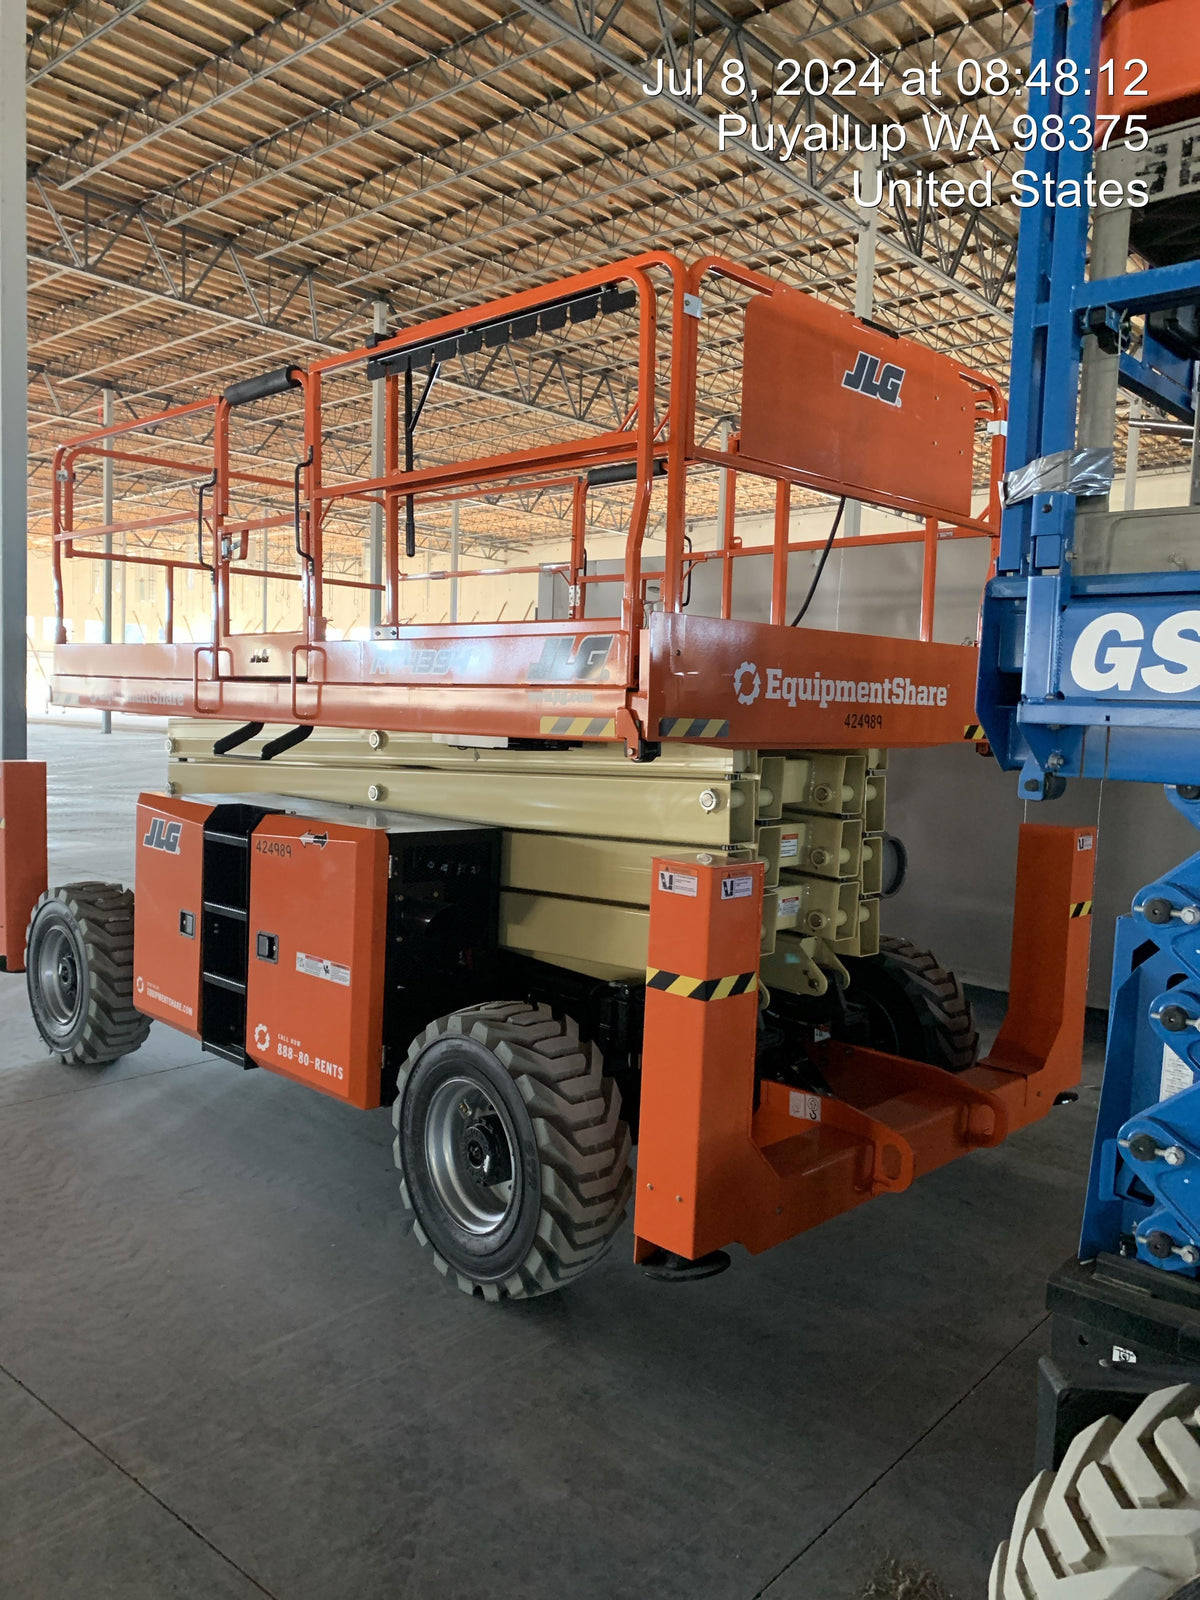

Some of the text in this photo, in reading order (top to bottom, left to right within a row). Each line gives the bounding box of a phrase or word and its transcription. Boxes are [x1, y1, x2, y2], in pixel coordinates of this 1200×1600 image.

[841, 350, 906, 408] JLG
[527, 633, 615, 681] JLG
[765, 668, 949, 708] EquipmentShare
[843, 713, 883, 730] 424989
[143, 817, 183, 855] JLG
[255, 840, 292, 858] 424989
[277, 1043, 343, 1080] 888-80-RENTS
